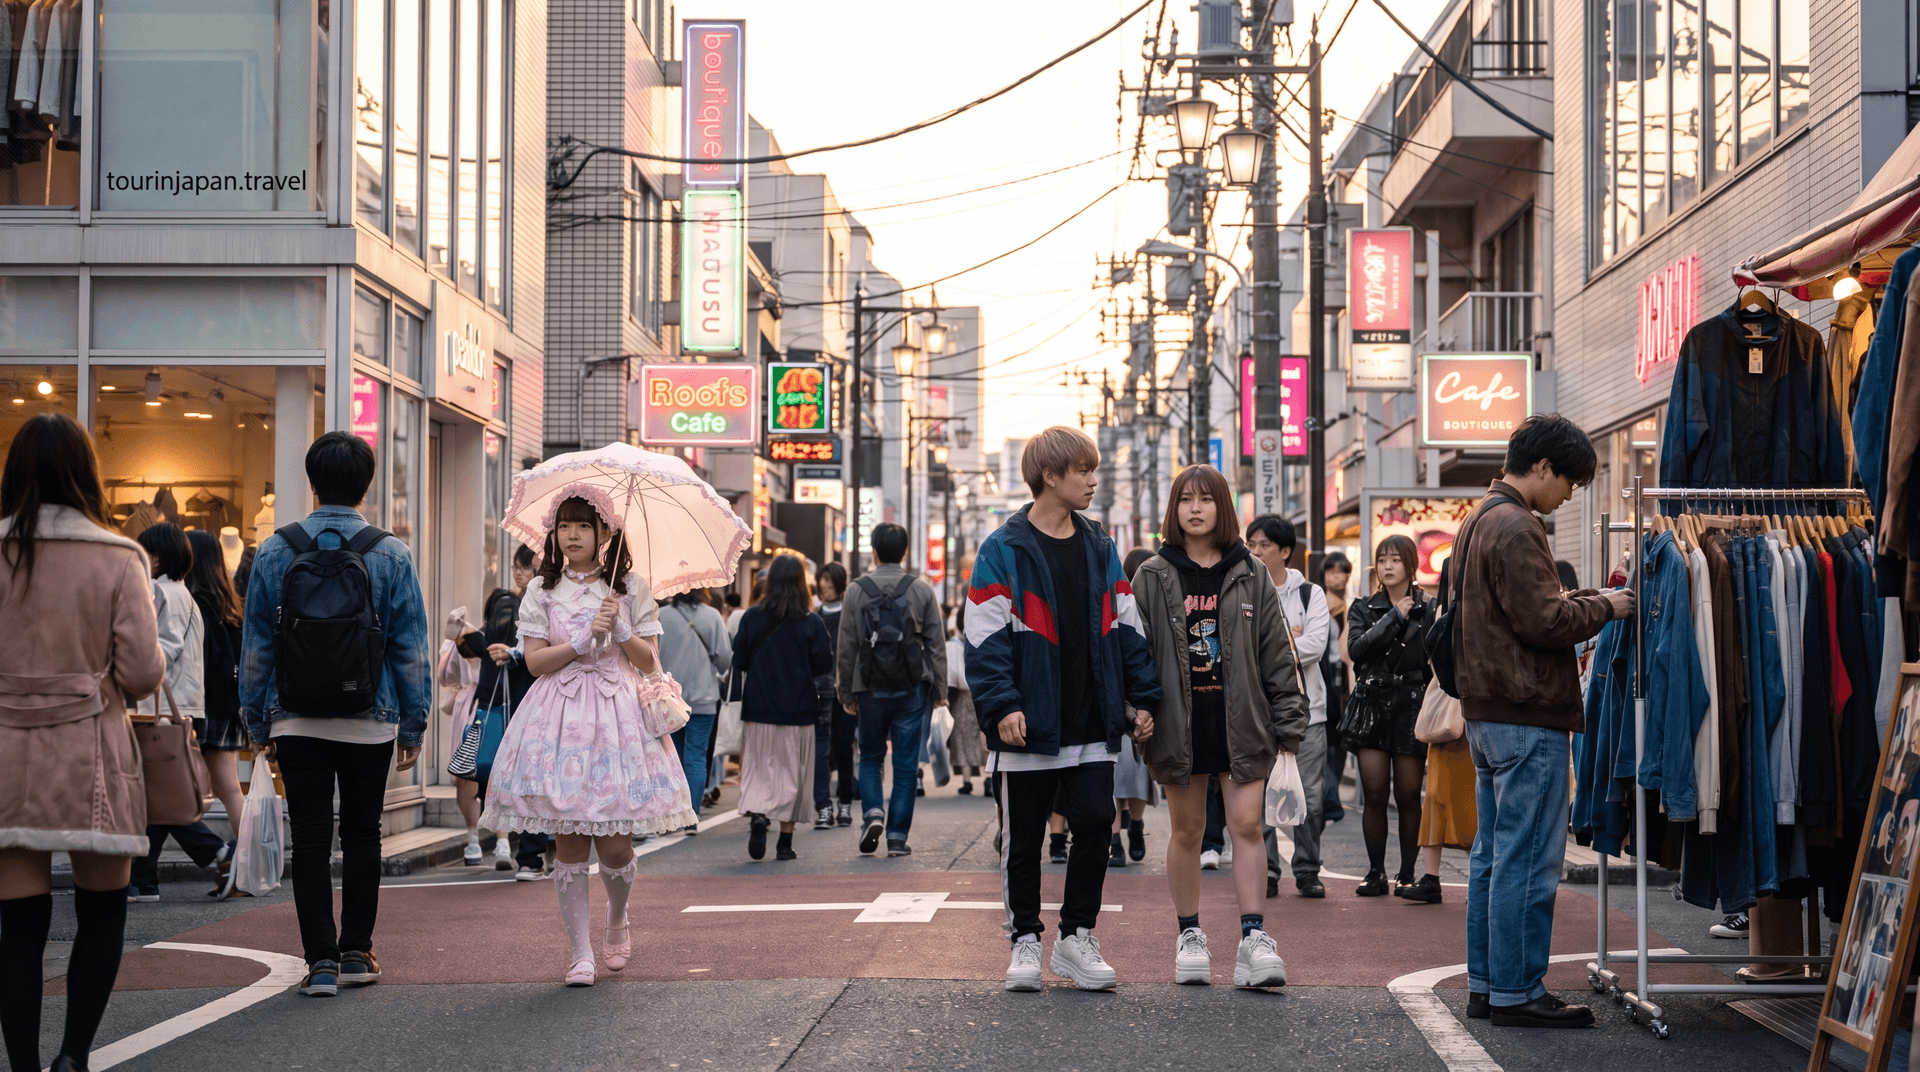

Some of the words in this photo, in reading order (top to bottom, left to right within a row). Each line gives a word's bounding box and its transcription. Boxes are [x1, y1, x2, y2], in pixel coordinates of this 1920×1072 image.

[649, 376, 748, 408] Roofs
[1435, 371, 1520, 411] Cafe
[670, 411, 727, 433] Cafe
